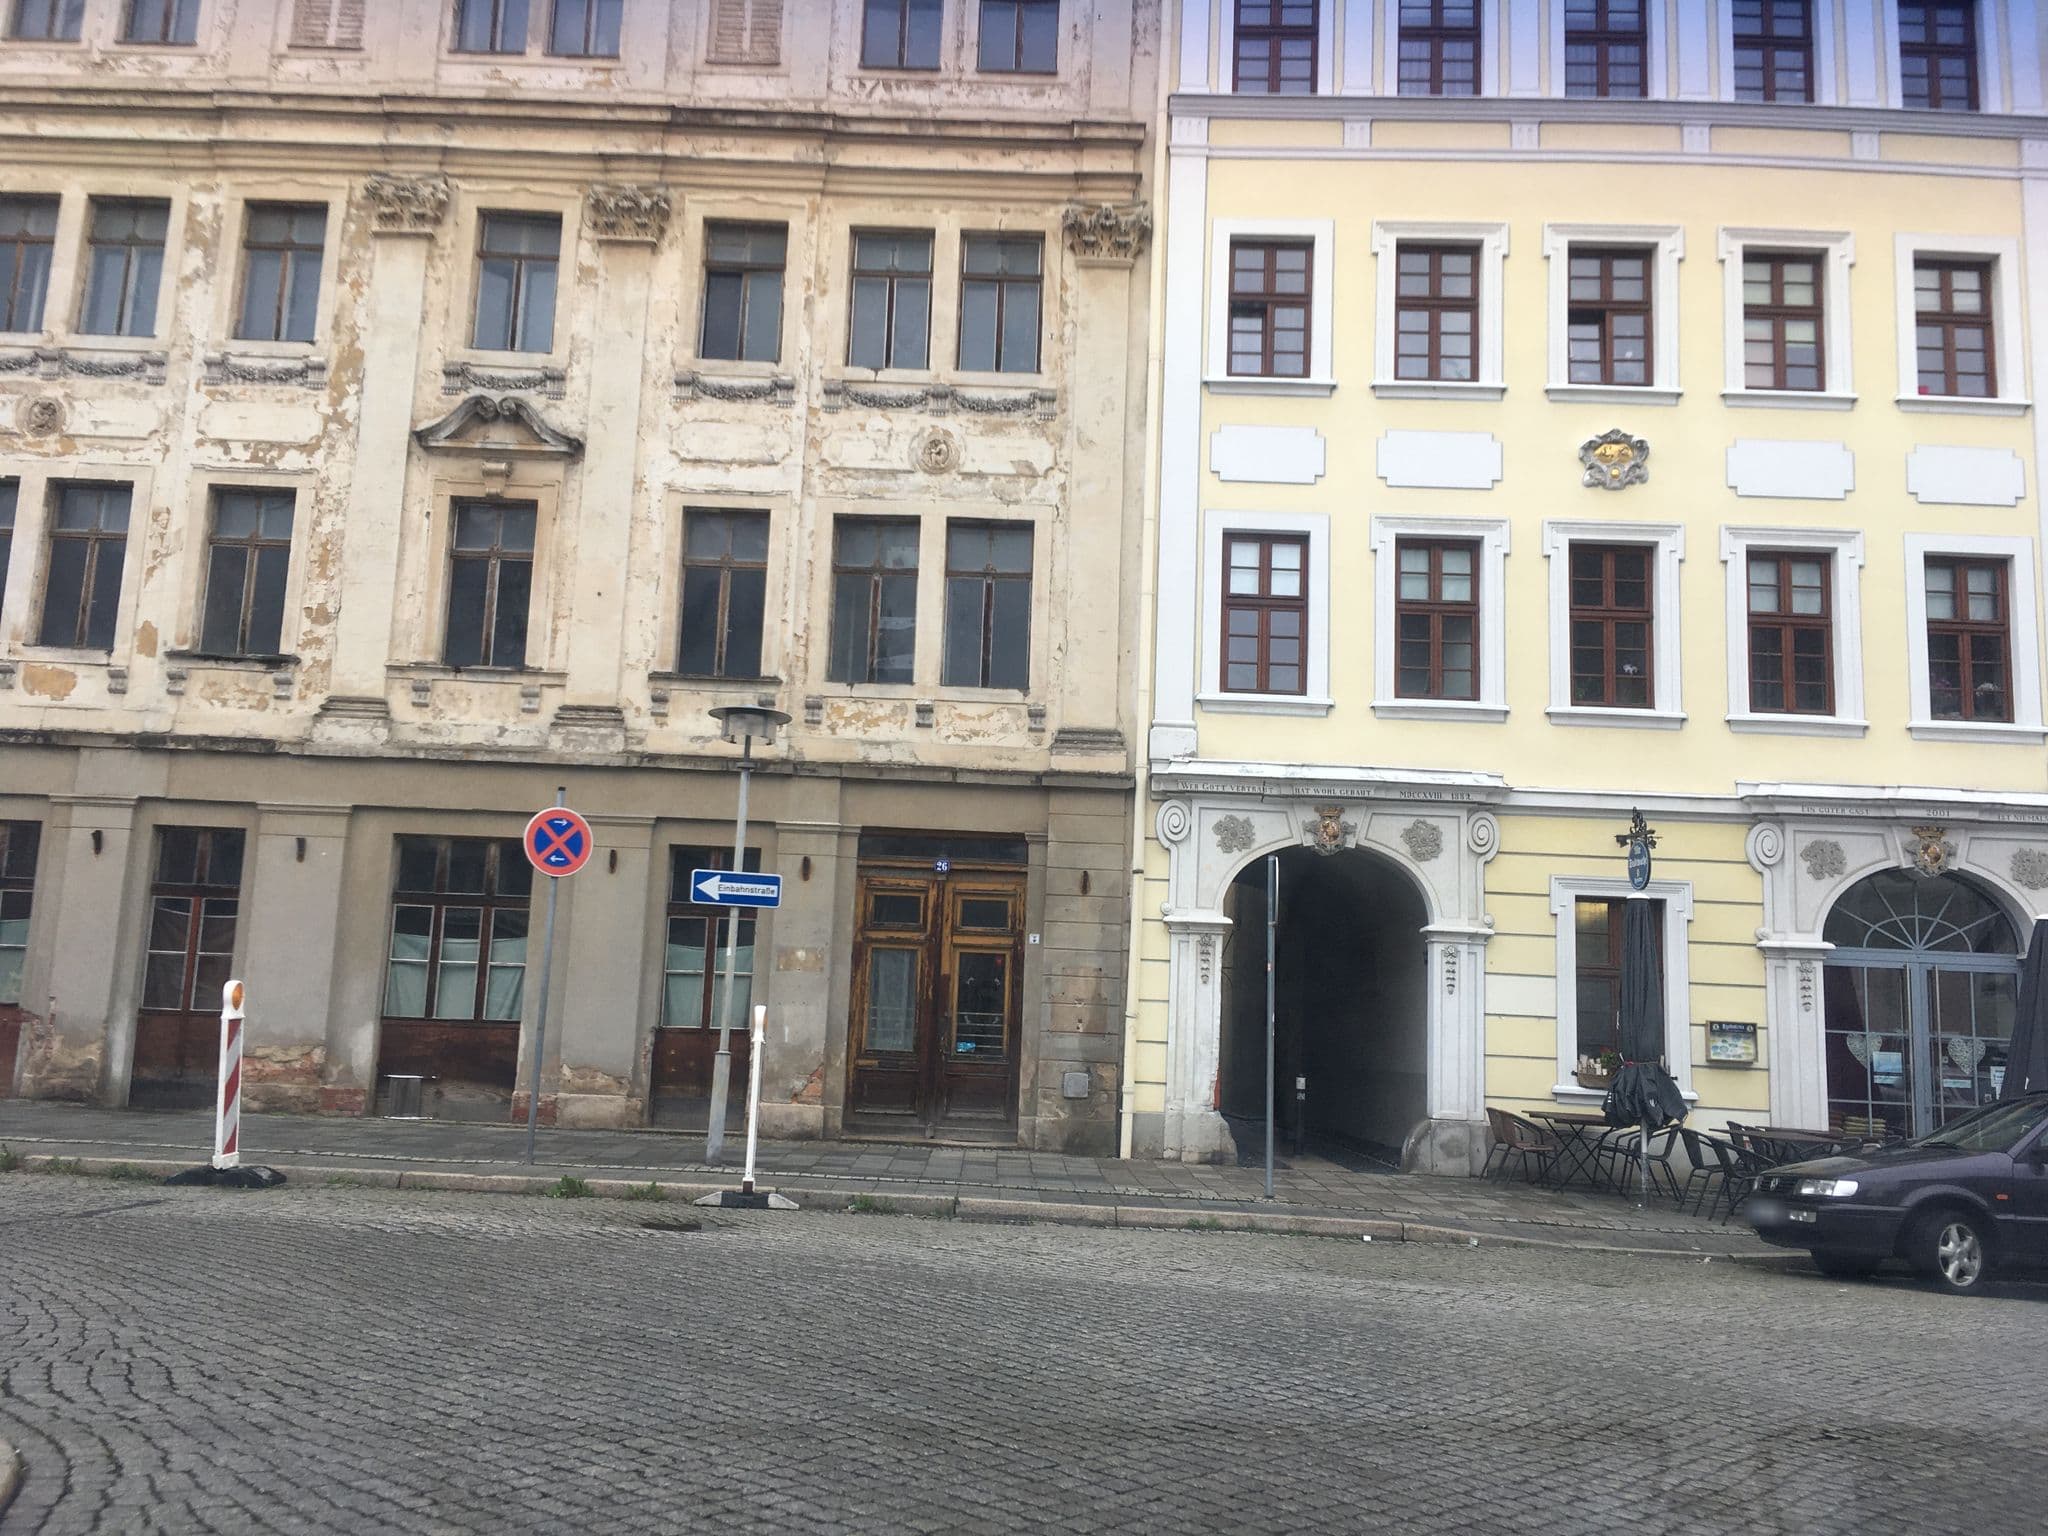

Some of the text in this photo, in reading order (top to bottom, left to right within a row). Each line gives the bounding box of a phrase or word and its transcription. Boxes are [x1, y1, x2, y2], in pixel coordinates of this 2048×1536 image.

[1294, 787, 1310, 795] HAT
[1312, 787, 1337, 796] WOHL
[1926, 808, 1951, 817] 2001
[936, 861, 948, 871] 26
[718, 884, 775, 895] Einbahnstraße
